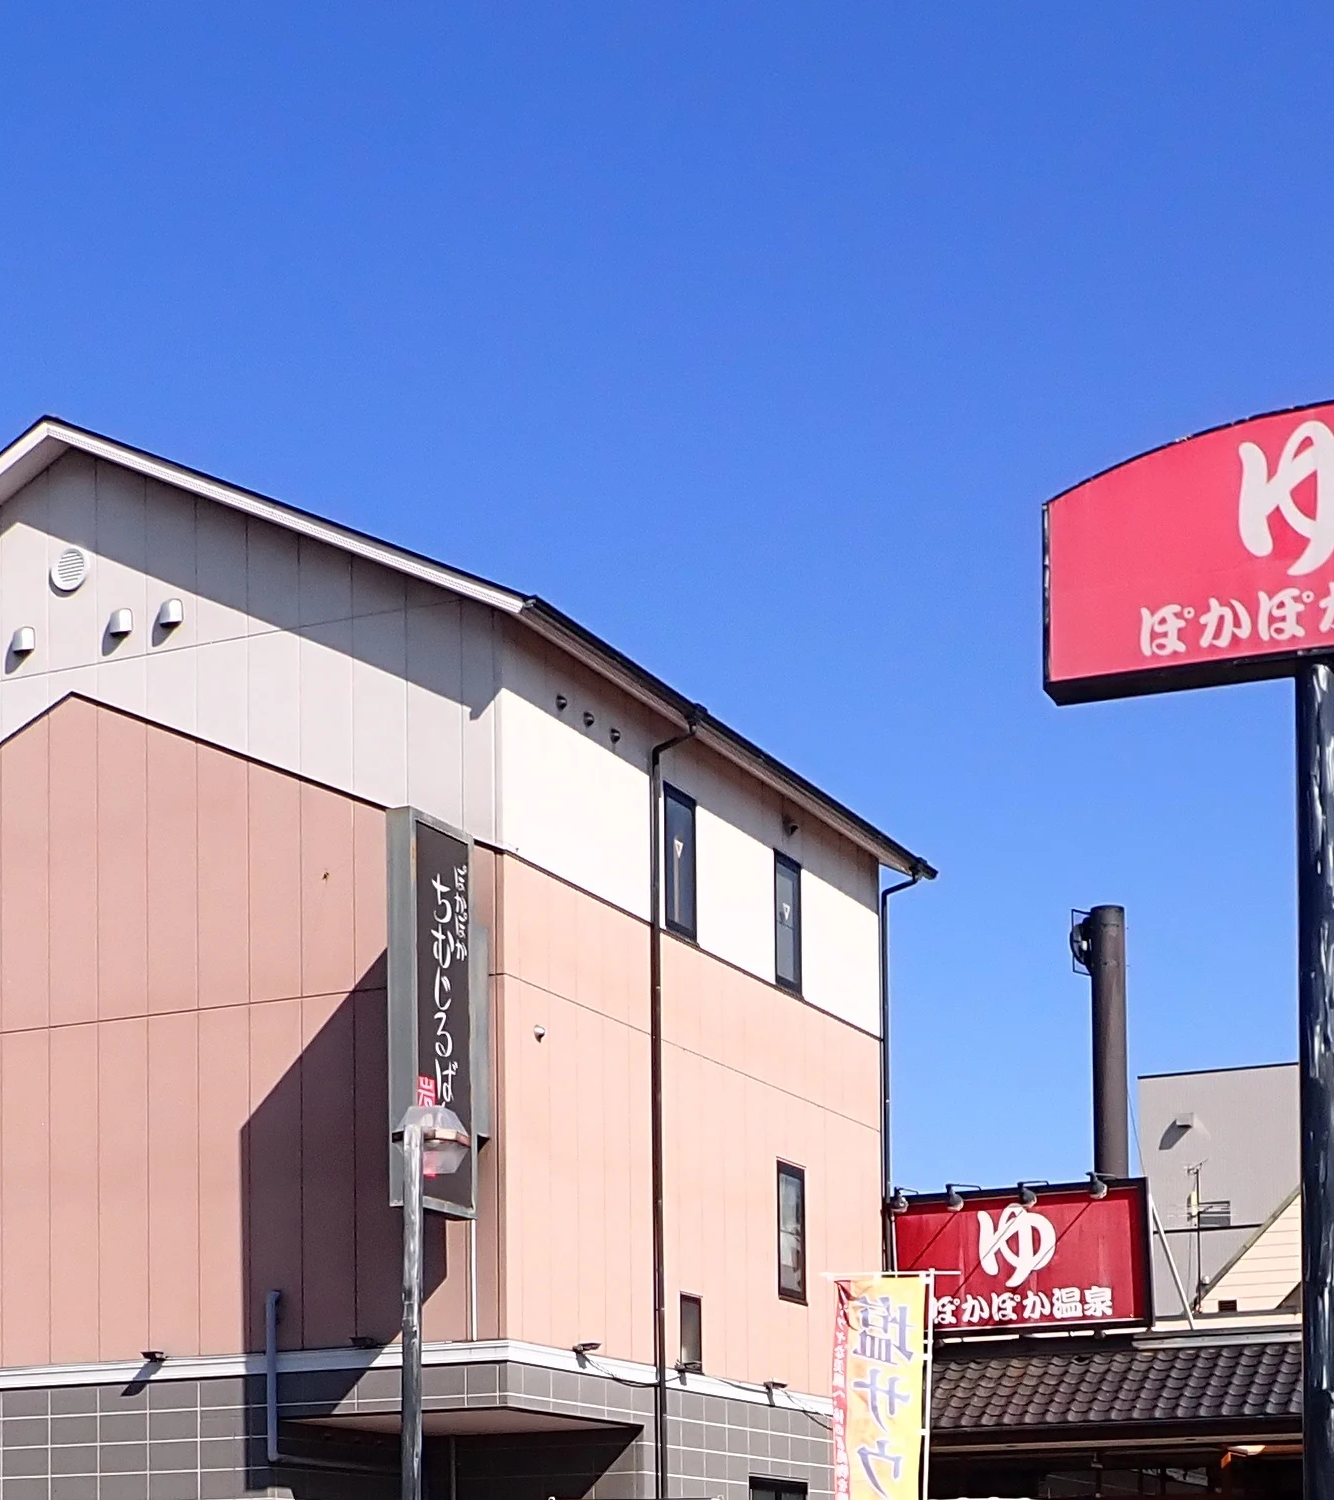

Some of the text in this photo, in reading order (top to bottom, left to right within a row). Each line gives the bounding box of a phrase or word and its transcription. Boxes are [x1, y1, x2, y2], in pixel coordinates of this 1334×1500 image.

[454, 865, 468, 961] ぽかぽか
[430, 873, 458, 1107] ちむじるば
[977, 1203, 1057, 1288] ゆ
[933, 1286, 1113, 1325] ぽかぽか温泉
